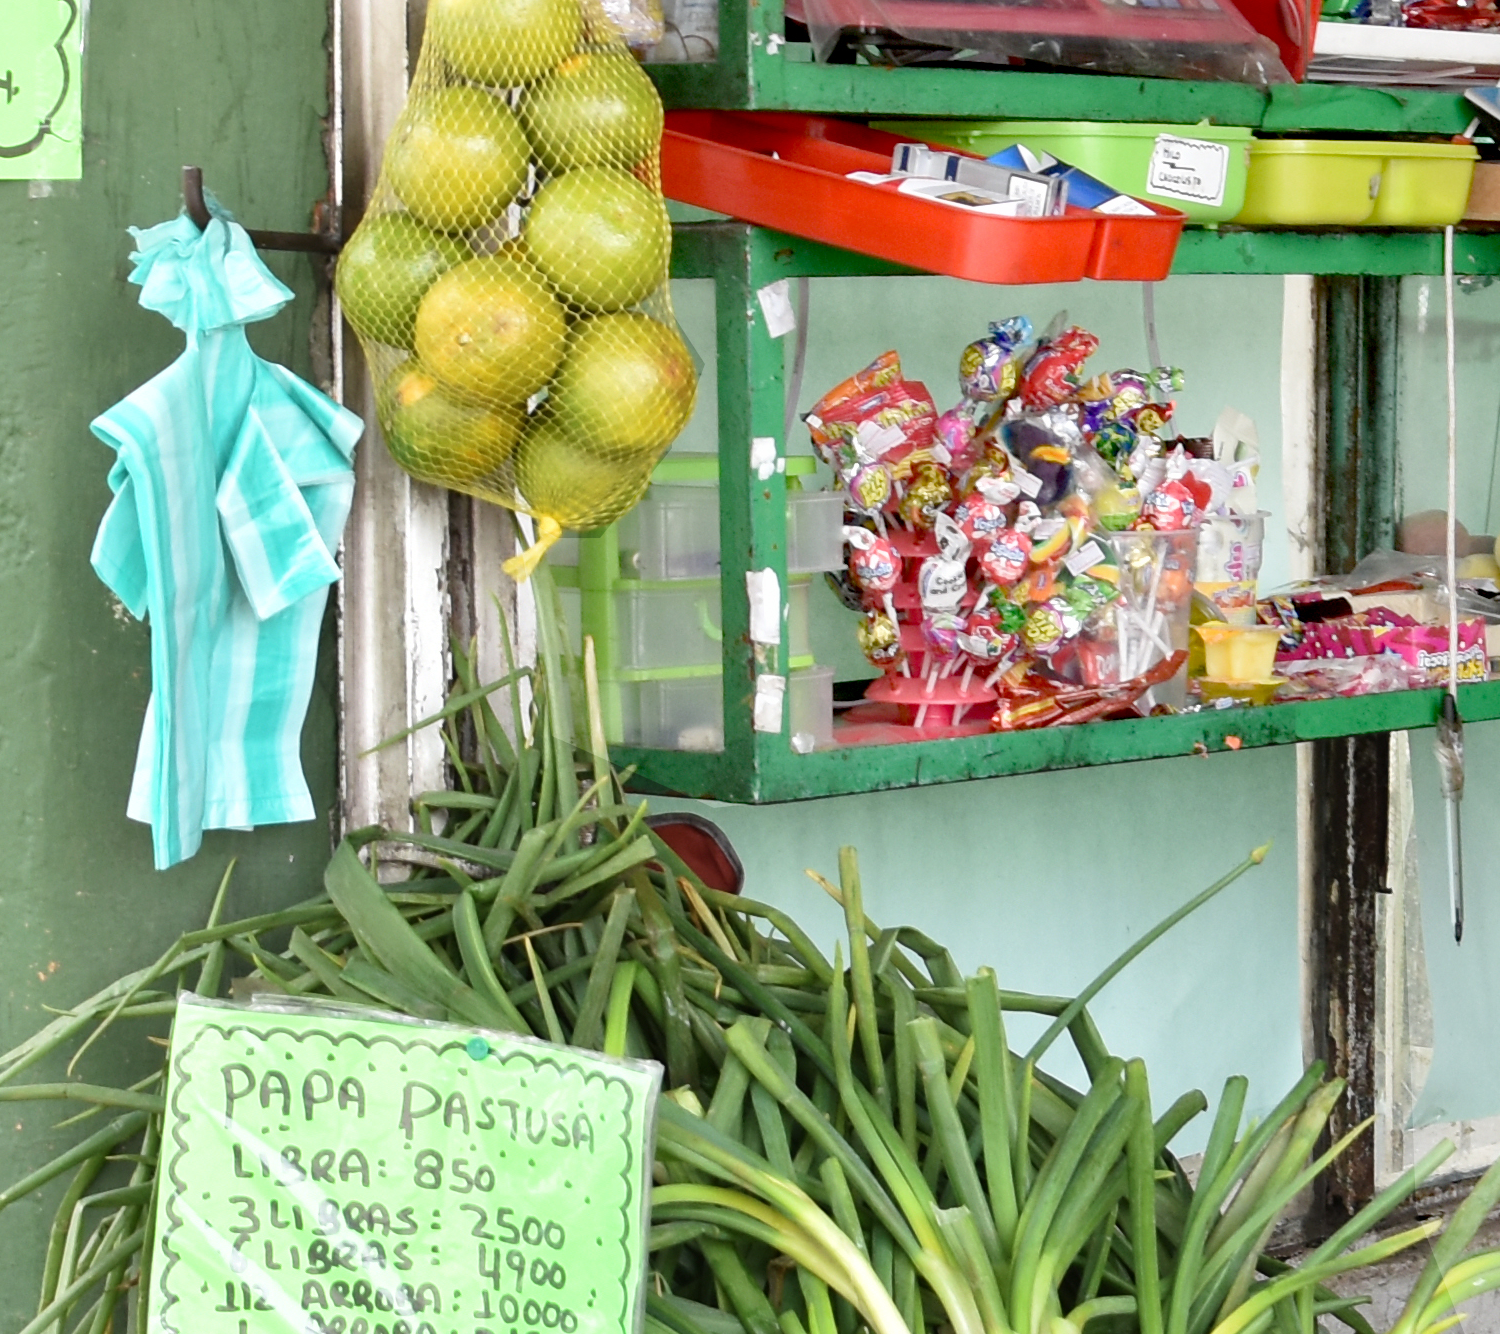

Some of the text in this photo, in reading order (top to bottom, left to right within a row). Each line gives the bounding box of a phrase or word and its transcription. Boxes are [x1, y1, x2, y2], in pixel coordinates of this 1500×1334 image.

[221, 1062, 595, 1154] PAPA PASTUSA
[413, 1149, 496, 1193] 850
[228, 1196, 261, 1234] 3
[460, 1203, 566, 1251] 2500
[477, 1242, 567, 1292] 4900
[473, 1292, 579, 1334] 10000
